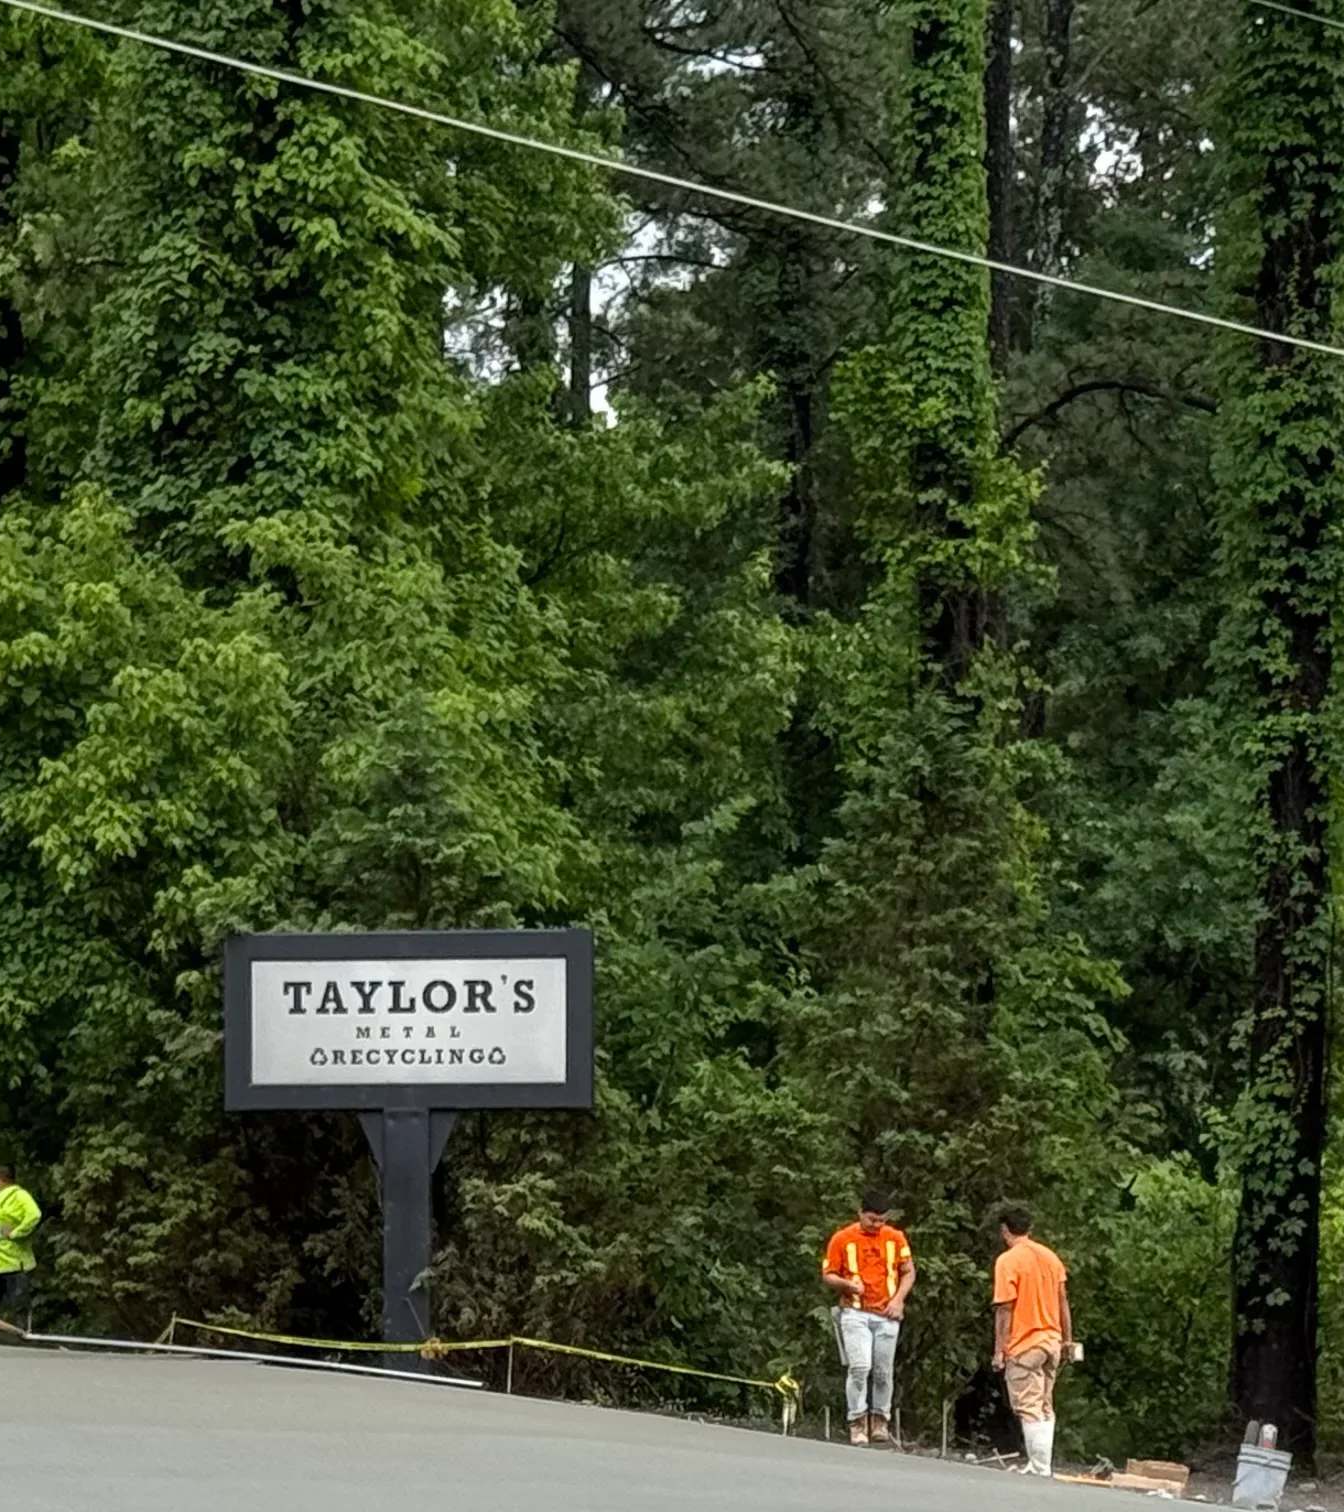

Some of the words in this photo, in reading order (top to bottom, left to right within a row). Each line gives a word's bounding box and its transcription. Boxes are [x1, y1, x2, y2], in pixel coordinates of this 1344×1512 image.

[282, 974, 536, 1015] TAYLOR'S
[355, 1025, 461, 1039] METAL
[331, 1048, 486, 1065] RECYCLING
